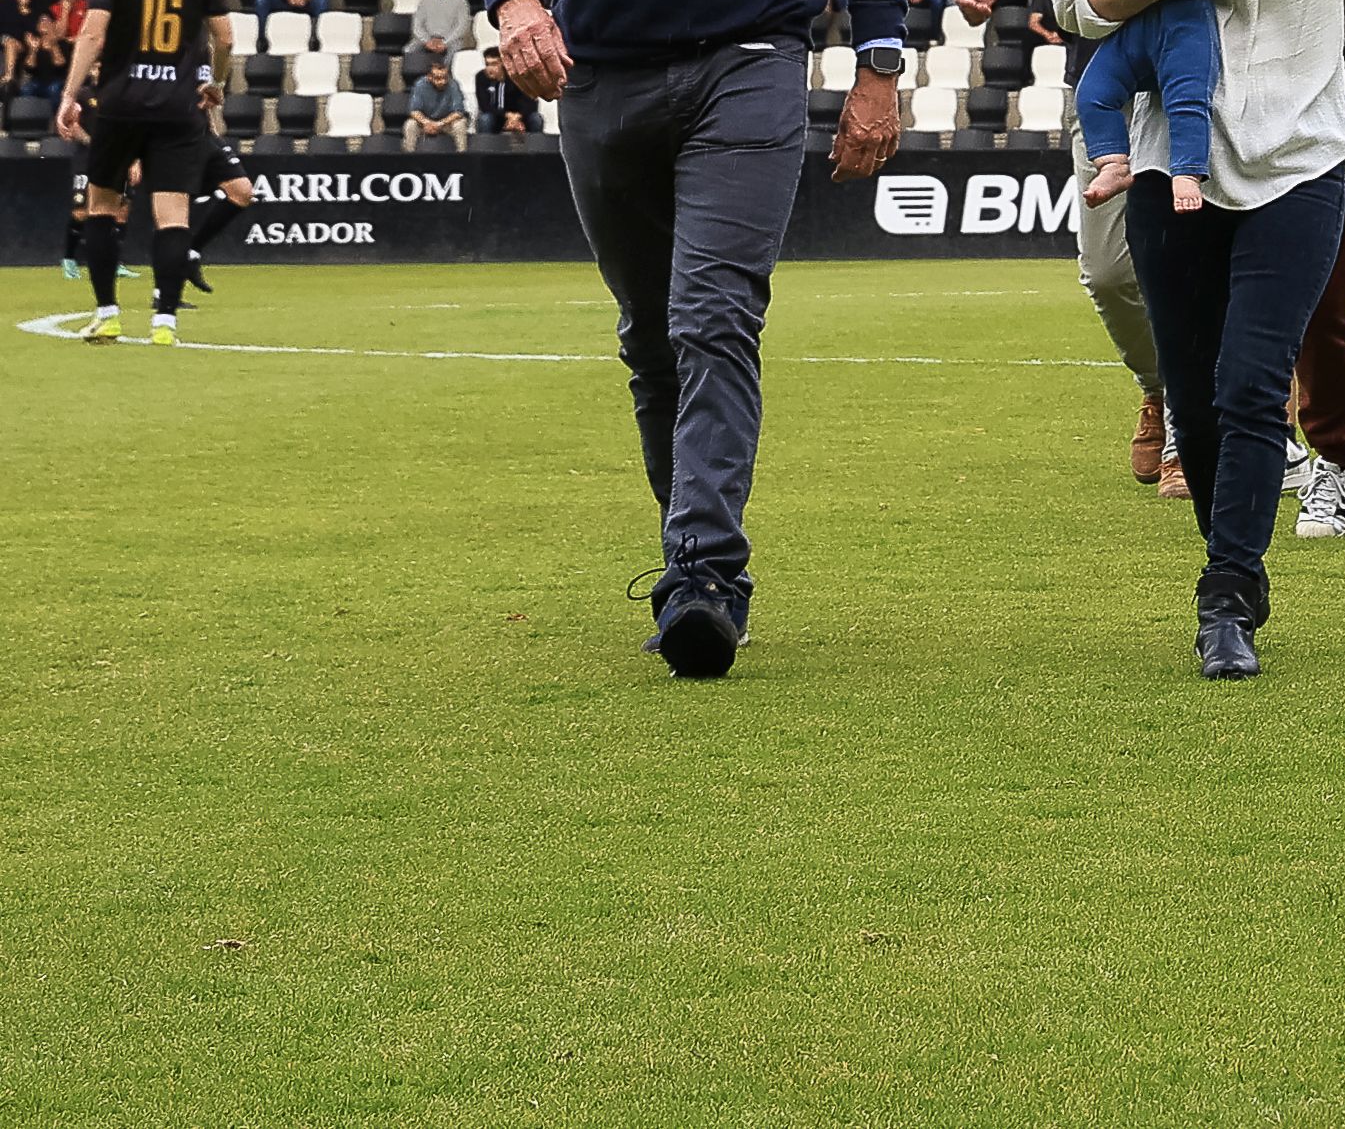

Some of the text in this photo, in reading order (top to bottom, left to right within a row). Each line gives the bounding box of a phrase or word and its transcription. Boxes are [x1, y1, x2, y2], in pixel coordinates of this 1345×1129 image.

[193, 173, 464, 202] ARRI.COM
[960, 174, 1080, 233] BM
[246, 222, 375, 245] ASADOR
